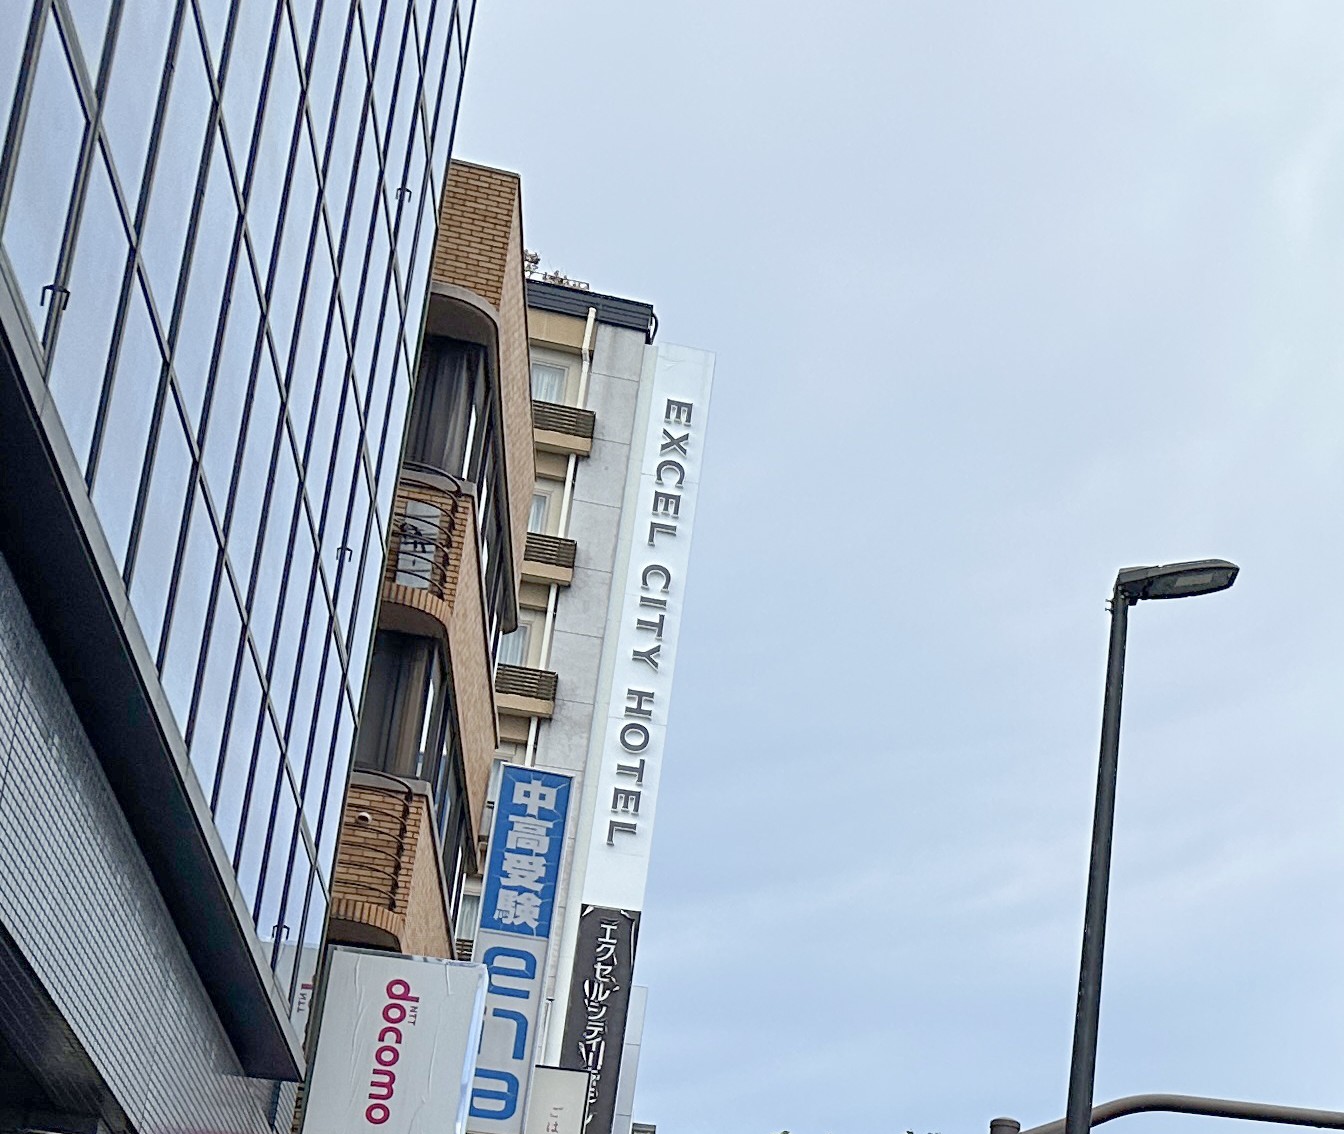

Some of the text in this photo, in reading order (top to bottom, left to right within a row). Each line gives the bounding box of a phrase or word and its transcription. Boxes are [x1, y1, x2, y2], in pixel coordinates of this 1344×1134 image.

[607, 398, 693, 846] EXCEL CITY HOTEL
[493, 780, 558, 930] 中高受験
[365, 978, 420, 1125] docomo
[408, 1005, 418, 1026] NTT
[469, 946, 537, 1121] ena
